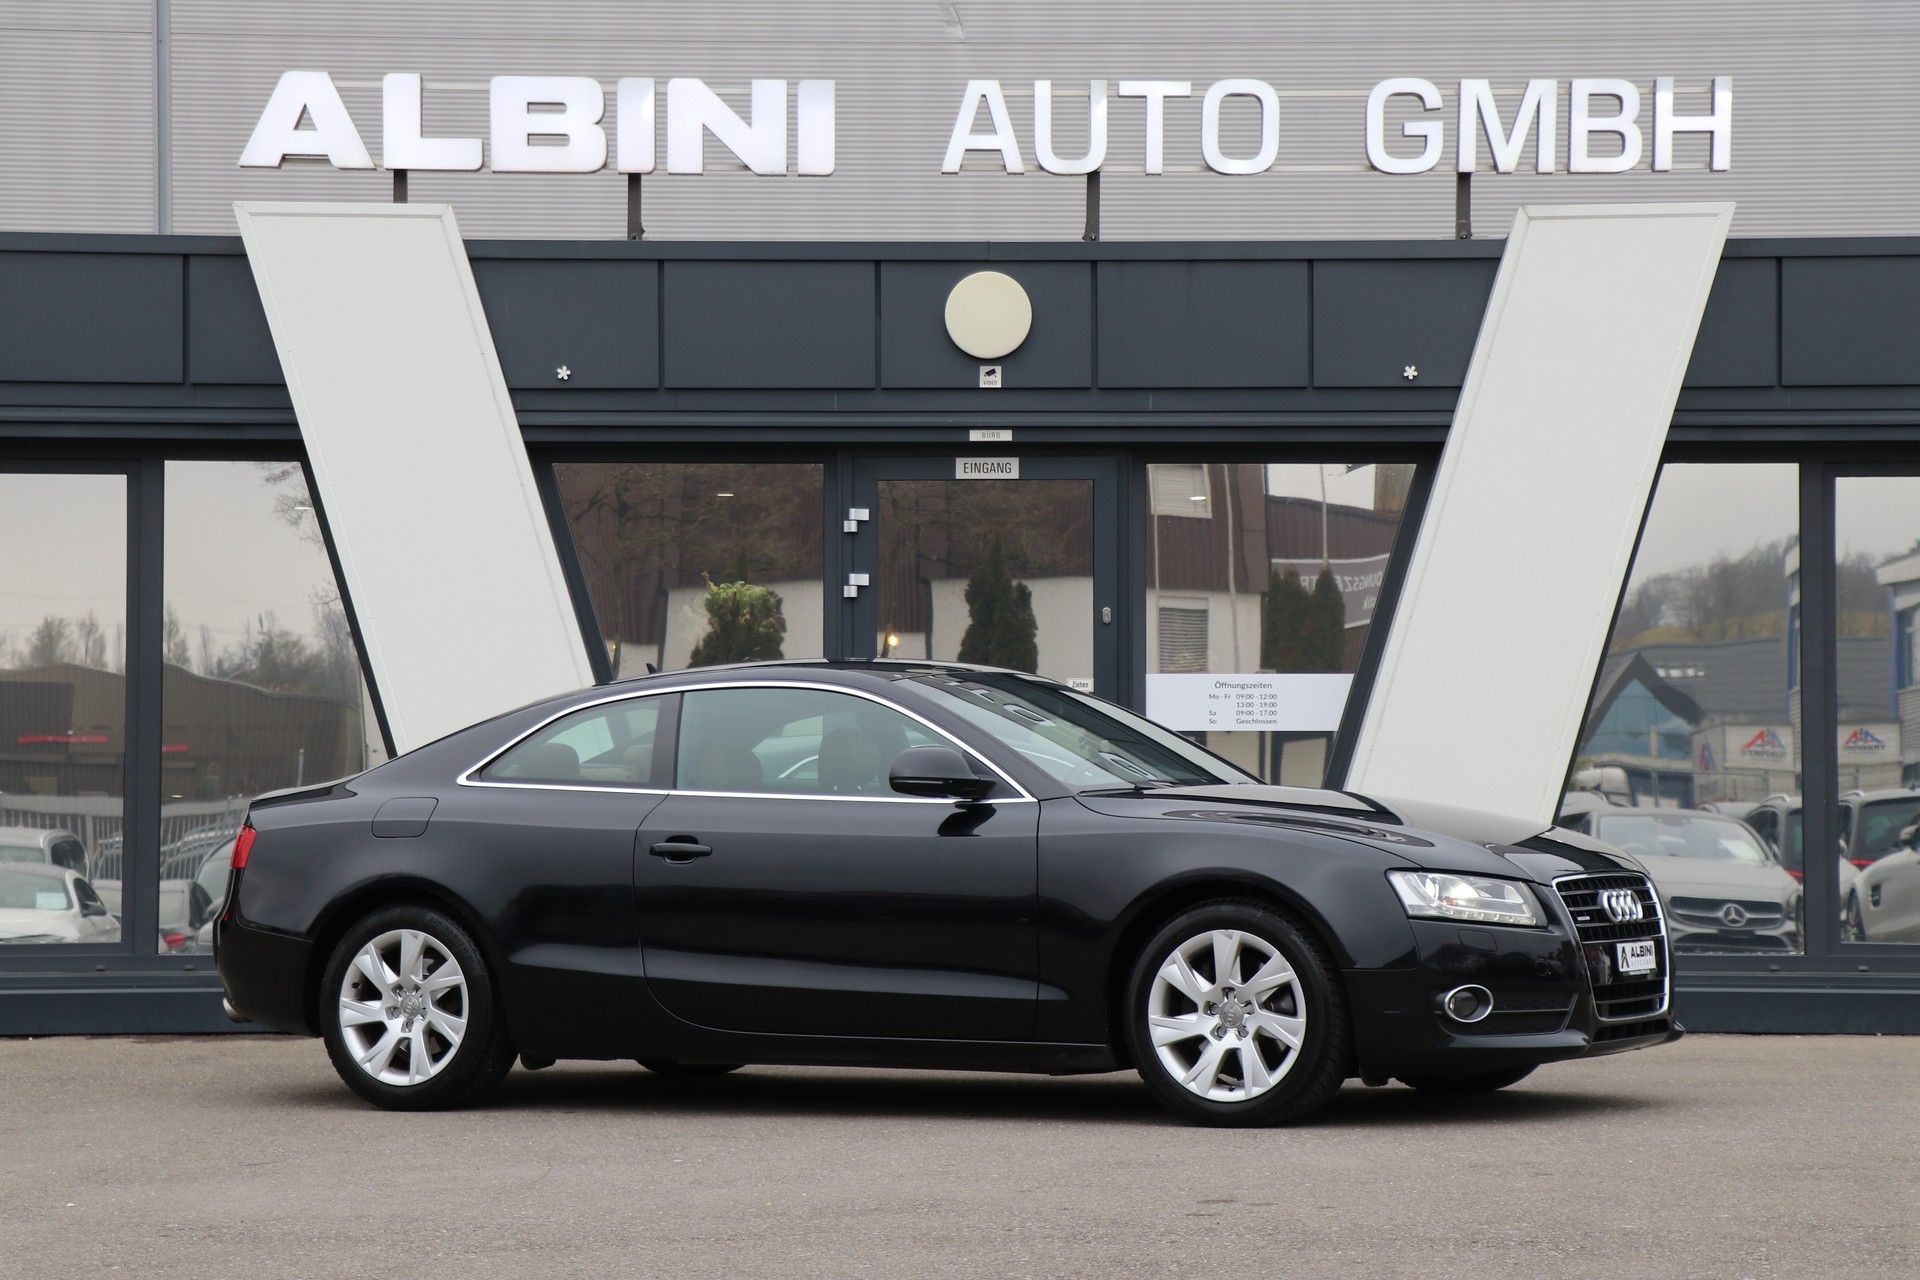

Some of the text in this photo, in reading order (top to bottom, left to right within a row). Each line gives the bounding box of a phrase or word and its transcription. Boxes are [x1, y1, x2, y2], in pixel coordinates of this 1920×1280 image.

[238, 71, 1733, 177] ALBINI AUTO GMBH
[981, 431, 1001, 439] BÜRO
[963, 462, 1012, 474] EINGANG
[1214, 681, 1273, 690] Öffnungszeiten
[1631, 945, 1653, 958] ALBINI
